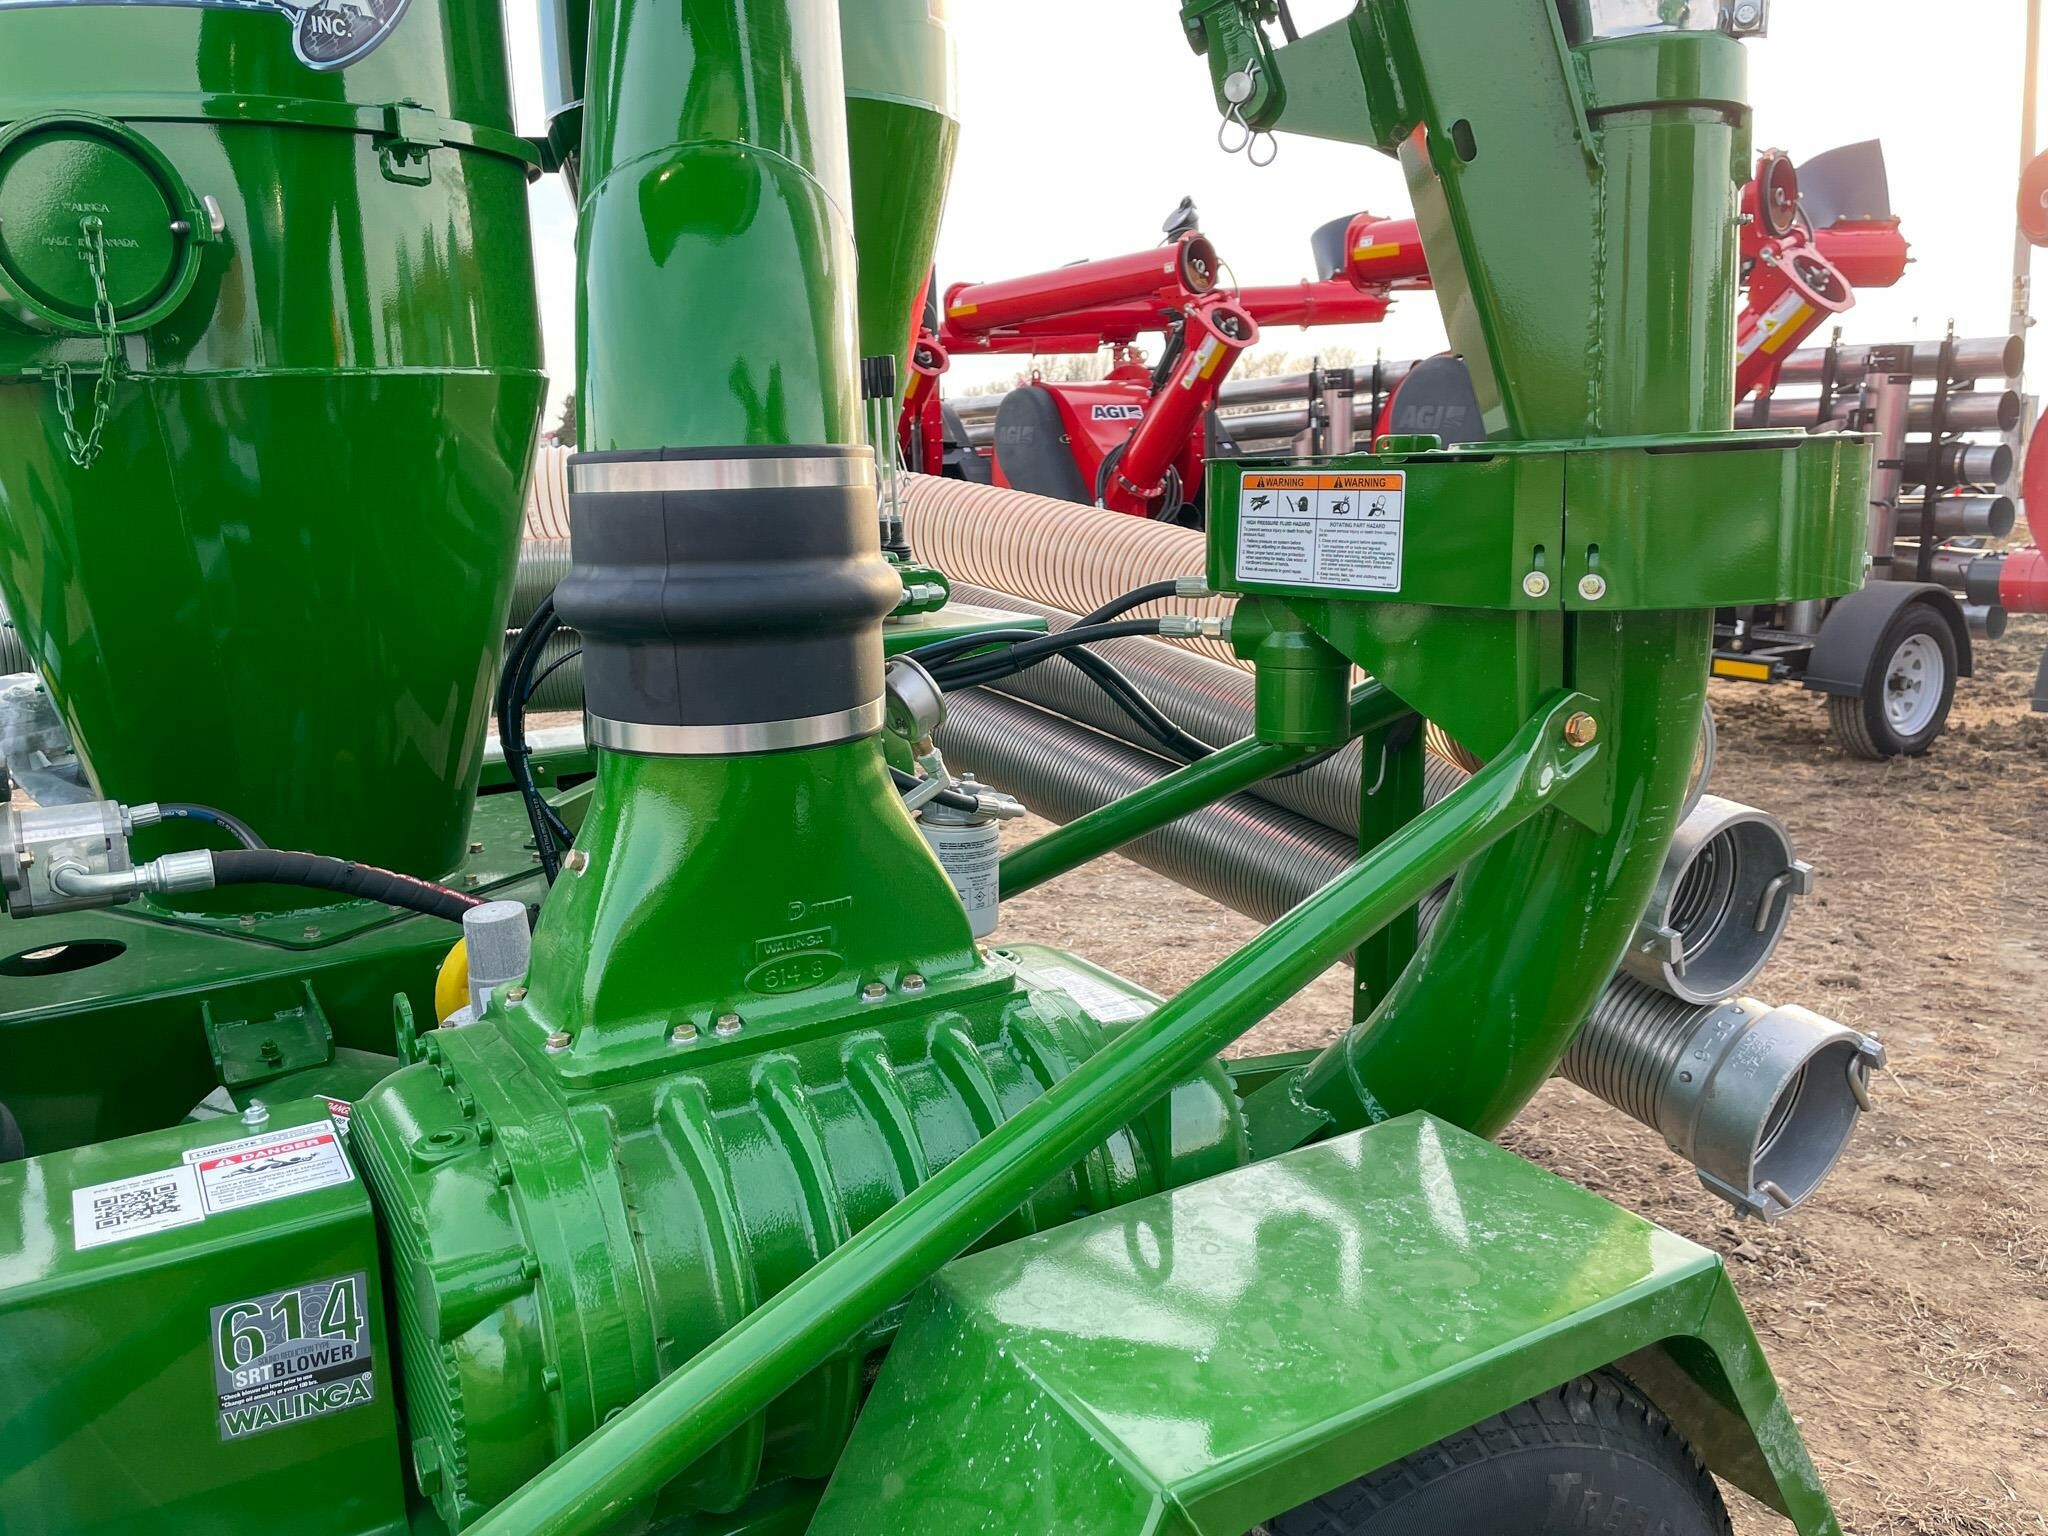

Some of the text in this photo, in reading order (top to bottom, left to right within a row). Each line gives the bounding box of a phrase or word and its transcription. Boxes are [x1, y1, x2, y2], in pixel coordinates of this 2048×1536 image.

[311, 15, 352, 38] INC.
[1094, 406, 1126, 419] AGI
[1398, 404, 1444, 429] AGI
[1266, 477, 1305, 487] WARNING
[1344, 477, 1386, 488] WARNING
[764, 935, 824, 955] WALINGA
[239, 1138, 320, 1161] DANGER
[219, 1277, 364, 1374] 614
[257, 1340, 329, 1365] SOUND REDUCTION TYPE
[241, 1386, 261, 1396] blower
[269, 1380, 283, 1390] level
[283, 1377, 295, 1386] prior
[302, 1373, 312, 1382] use
[253, 1389, 276, 1401] annually
[277, 1387, 283, 1395] or
[283, 1384, 298, 1394] every
[298, 1381, 308, 1390] 100
[308, 1379, 319, 1388] hrs.
